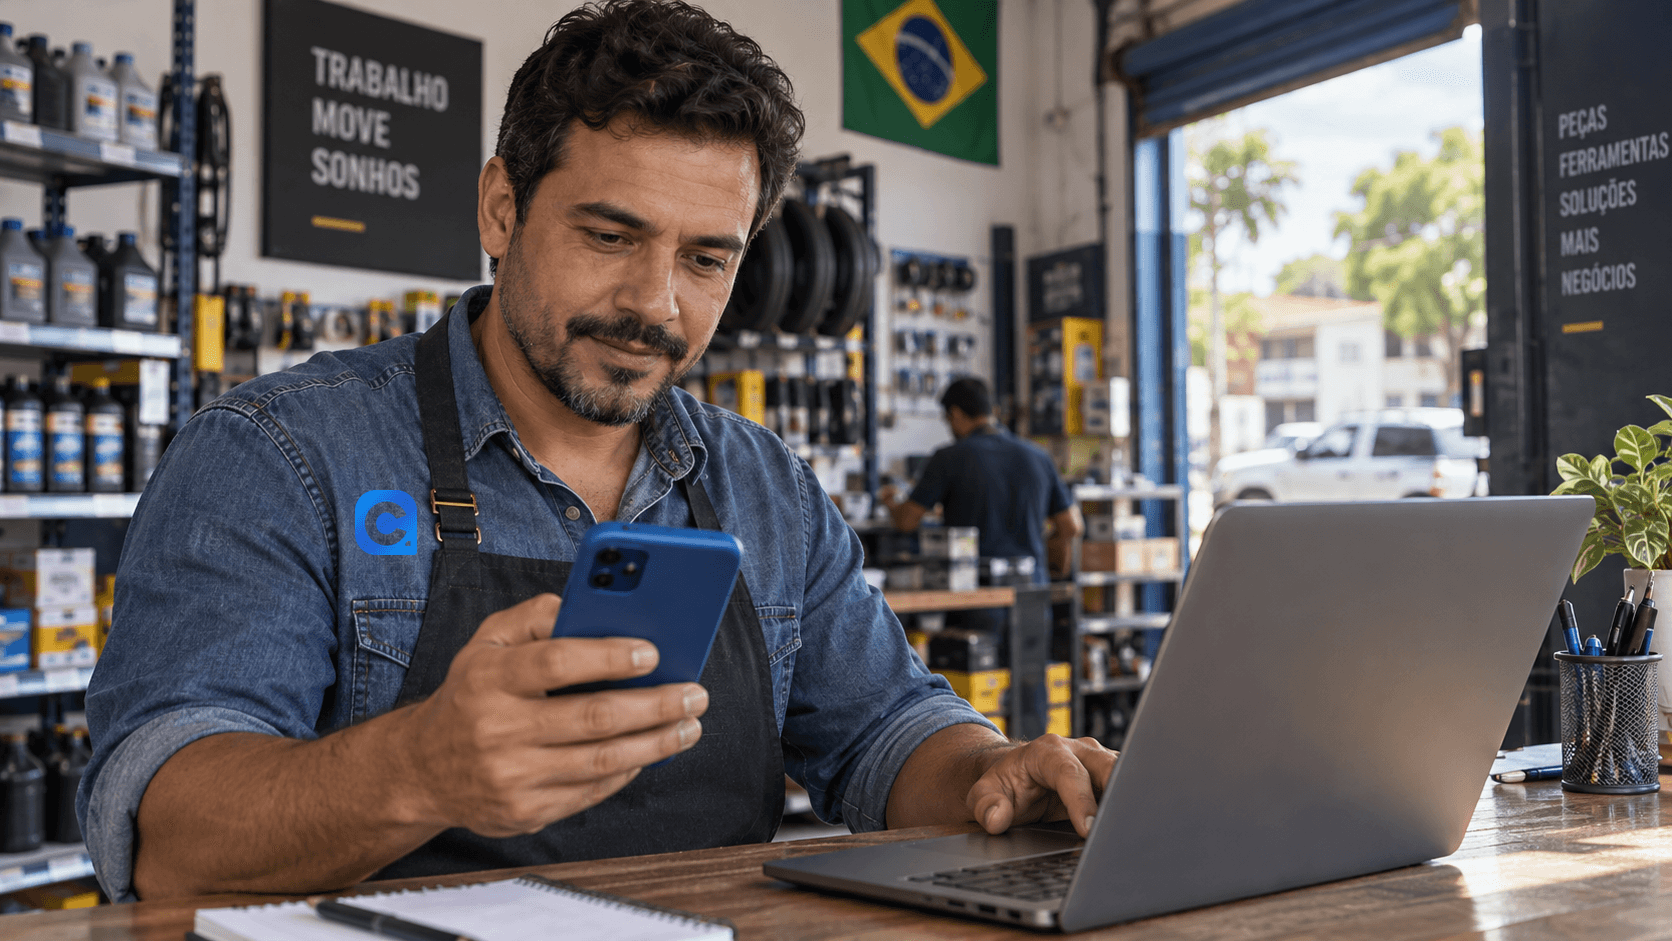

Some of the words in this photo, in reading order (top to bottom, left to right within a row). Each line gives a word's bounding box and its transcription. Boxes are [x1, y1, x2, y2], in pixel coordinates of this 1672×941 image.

[311, 46, 449, 112] TRABALHO
[312, 97, 391, 148] MOVE
[1558, 104, 1607, 140] PEÇAS
[311, 147, 420, 200] SONHOS
[1559, 132, 1669, 178] FERRAMENTAS
[1560, 177, 1637, 217] SOLUÇÕES
[1560, 227, 1600, 256] MAIS
[1561, 262, 1637, 296] NEGÓCIOS
